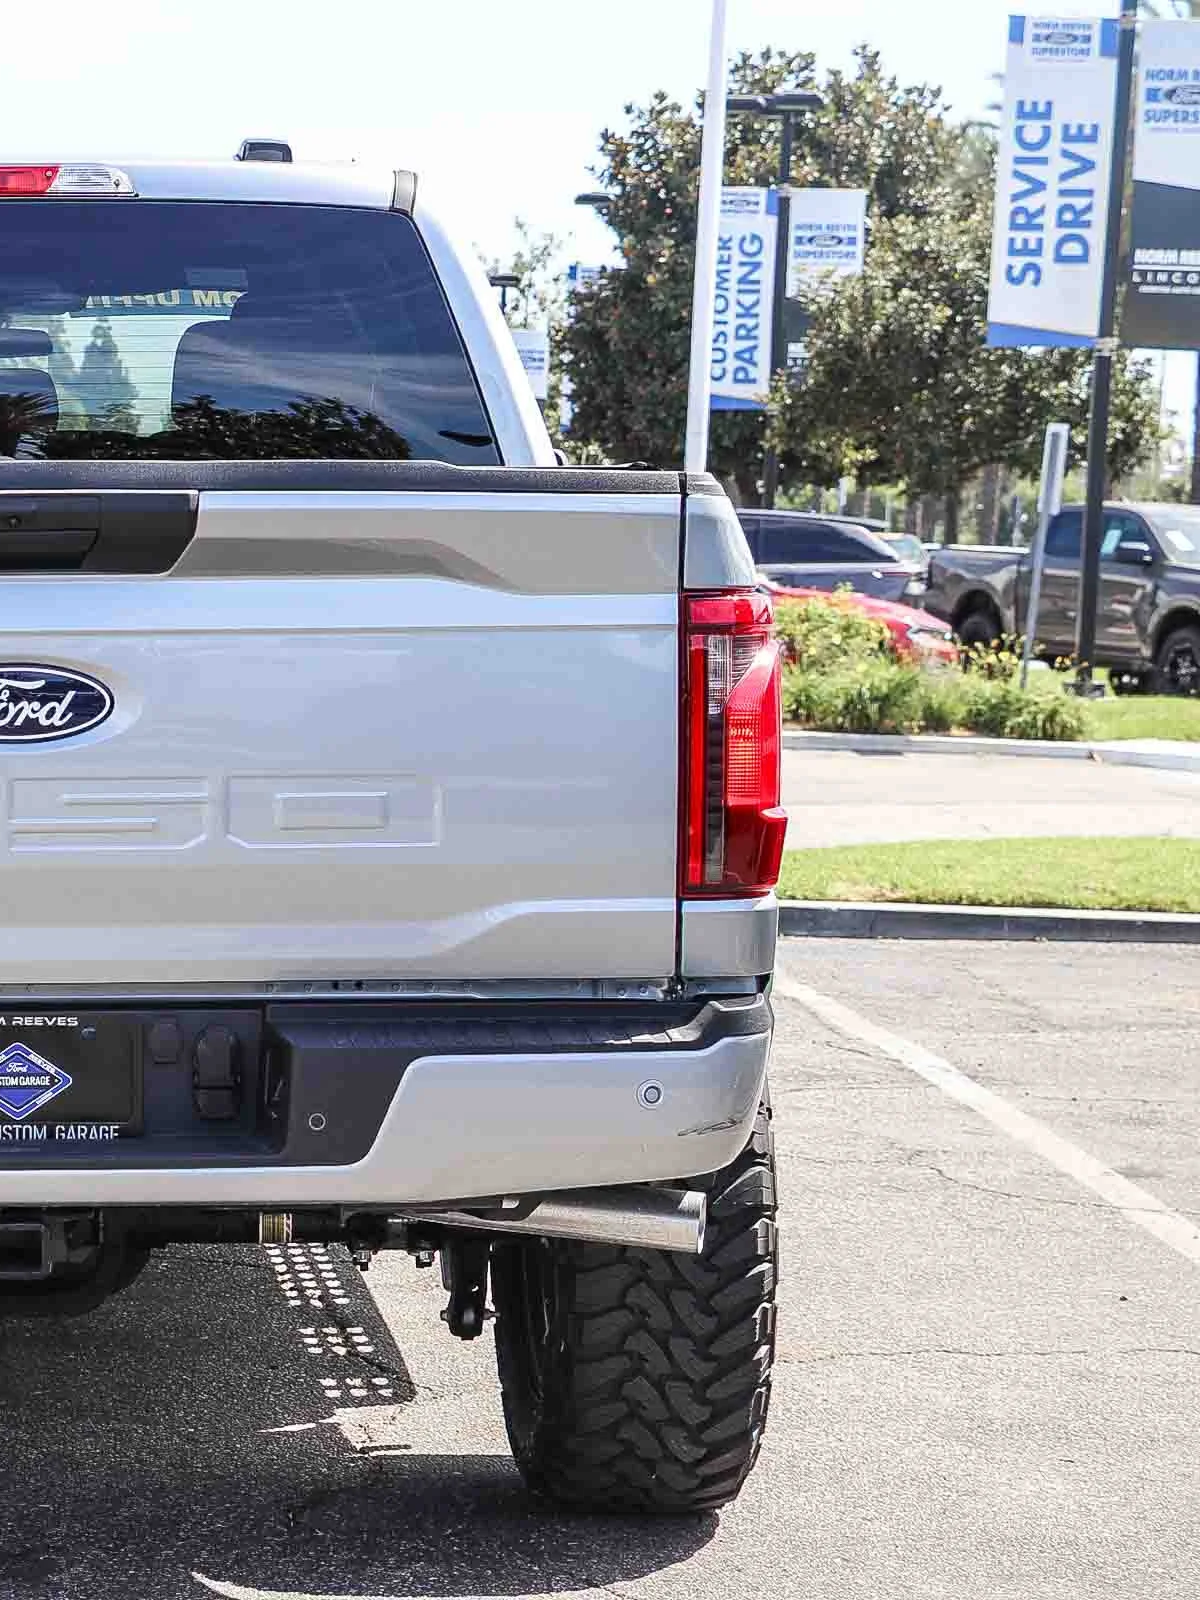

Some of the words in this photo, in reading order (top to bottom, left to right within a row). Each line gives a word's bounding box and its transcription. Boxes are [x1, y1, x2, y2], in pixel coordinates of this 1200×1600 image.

[1006, 99, 1053, 287] SERVICE
[1054, 122, 1099, 264] DRIVE
[734, 232, 764, 385] PARKING
[12, 1016, 79, 1027] REEVES
[6, 1062, 29, 1073] Ford
[19, 1075, 51, 1086] GARAGE
[55, 1124, 120, 1141] GARAGE
